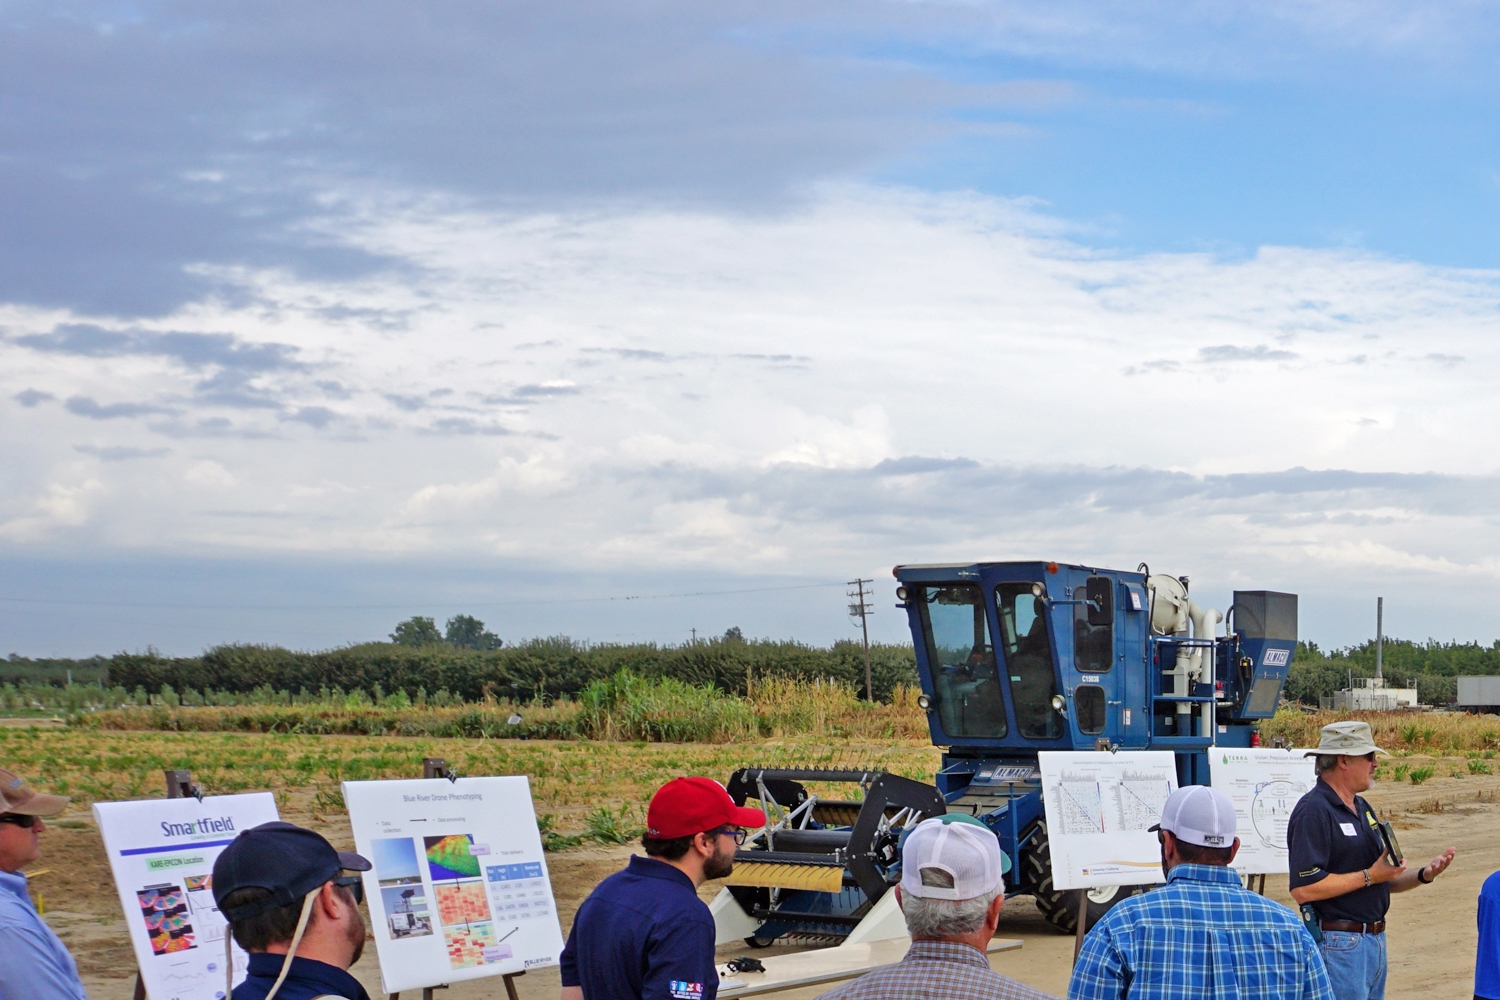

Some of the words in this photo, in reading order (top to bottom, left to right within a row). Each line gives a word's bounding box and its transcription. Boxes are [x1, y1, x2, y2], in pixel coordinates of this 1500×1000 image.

[1266, 651, 1288, 664] ALMACO
[996, 768, 1032, 778] ALMACO
[403, 794, 416, 802] Blue
[431, 793, 448, 801] Drone
[449, 792, 483, 802] Phenotyping
[161, 815, 235, 837] Smartfield
[183, 856, 204, 865] Location
